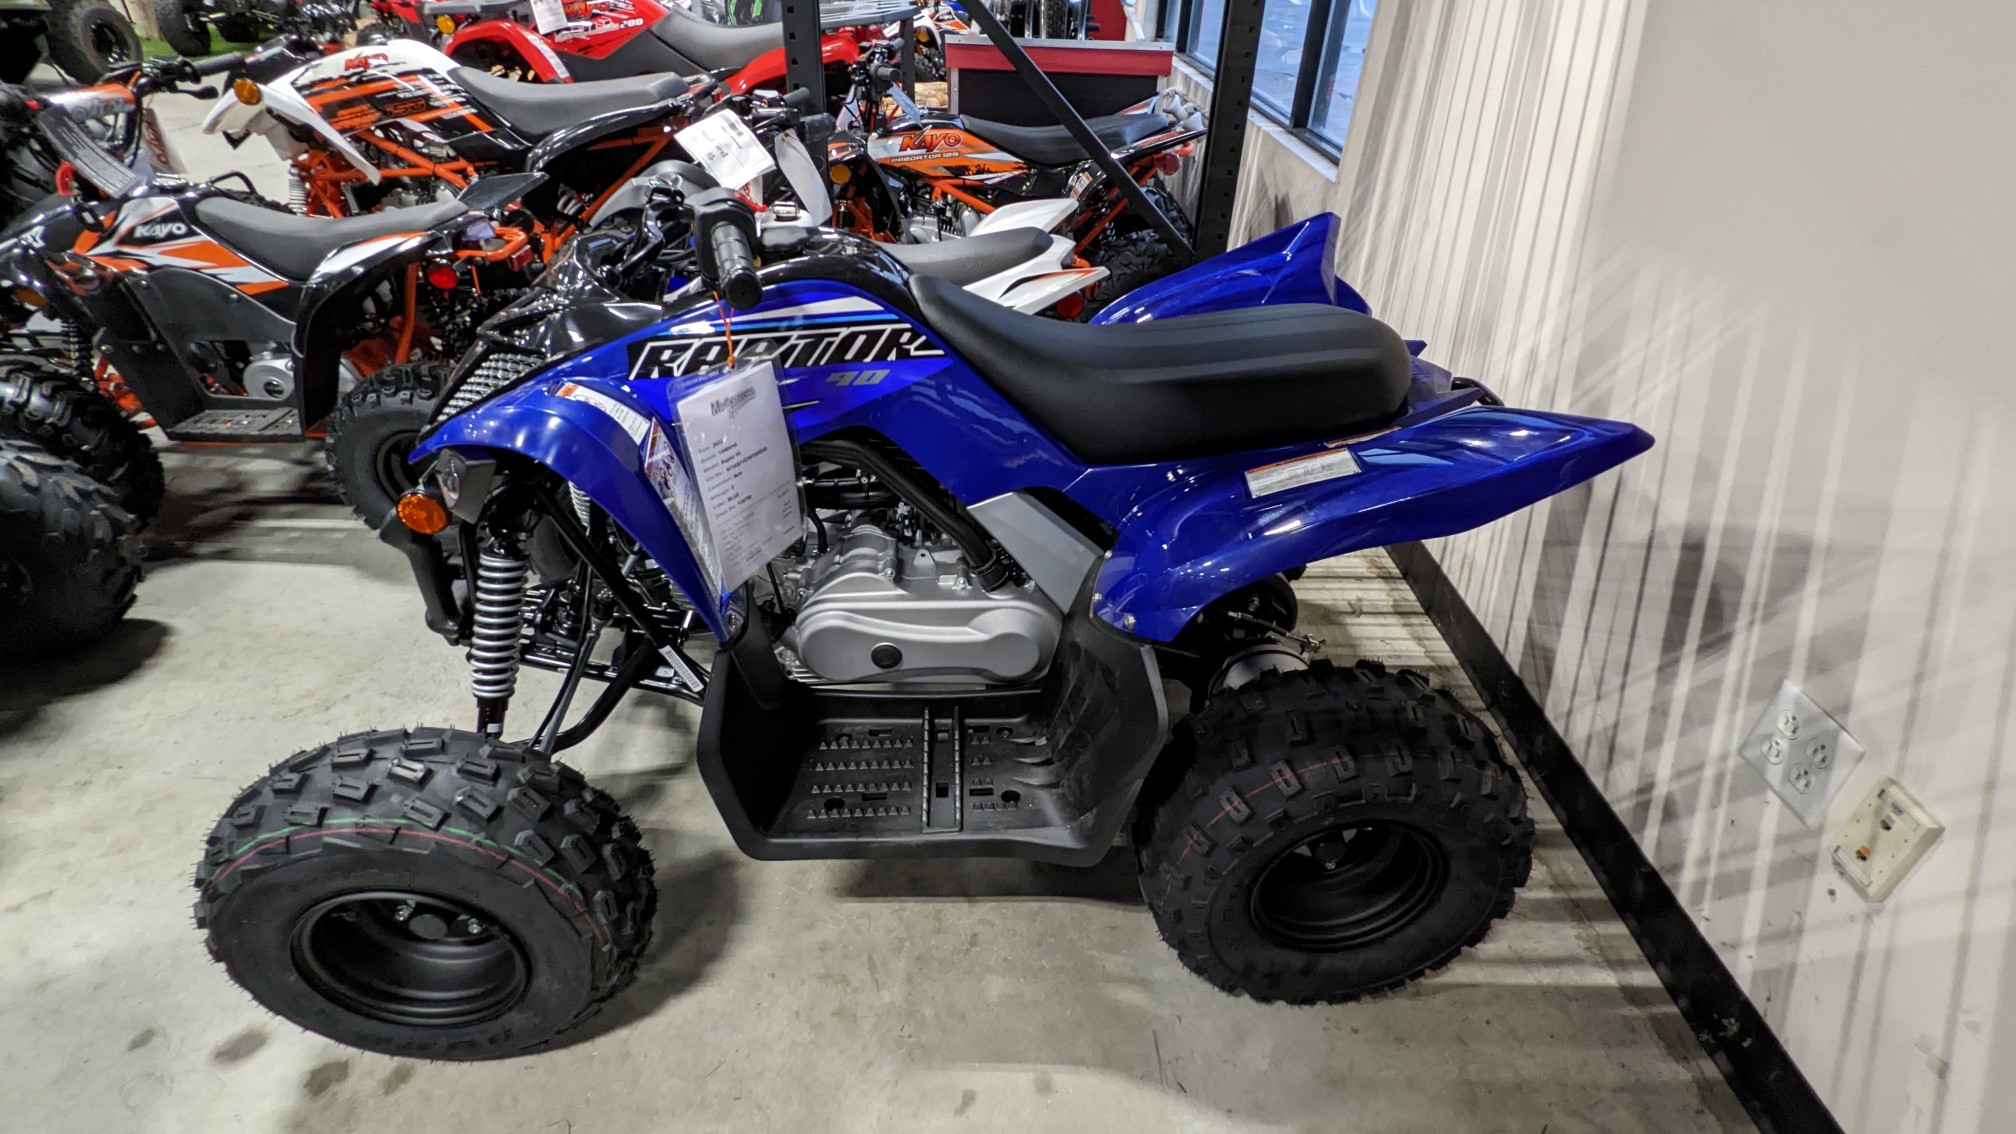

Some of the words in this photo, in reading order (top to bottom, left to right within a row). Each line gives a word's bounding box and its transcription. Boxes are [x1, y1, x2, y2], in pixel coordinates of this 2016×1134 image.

[620, 18, 644, 28] 200
[344, 51, 389, 71] KAYO
[899, 126, 962, 152] KAYO
[891, 153, 941, 163] PREDATOR
[133, 222, 188, 238] KAYO
[628, 323, 945, 381] RAPTOR
[826, 369, 890, 387] 90
